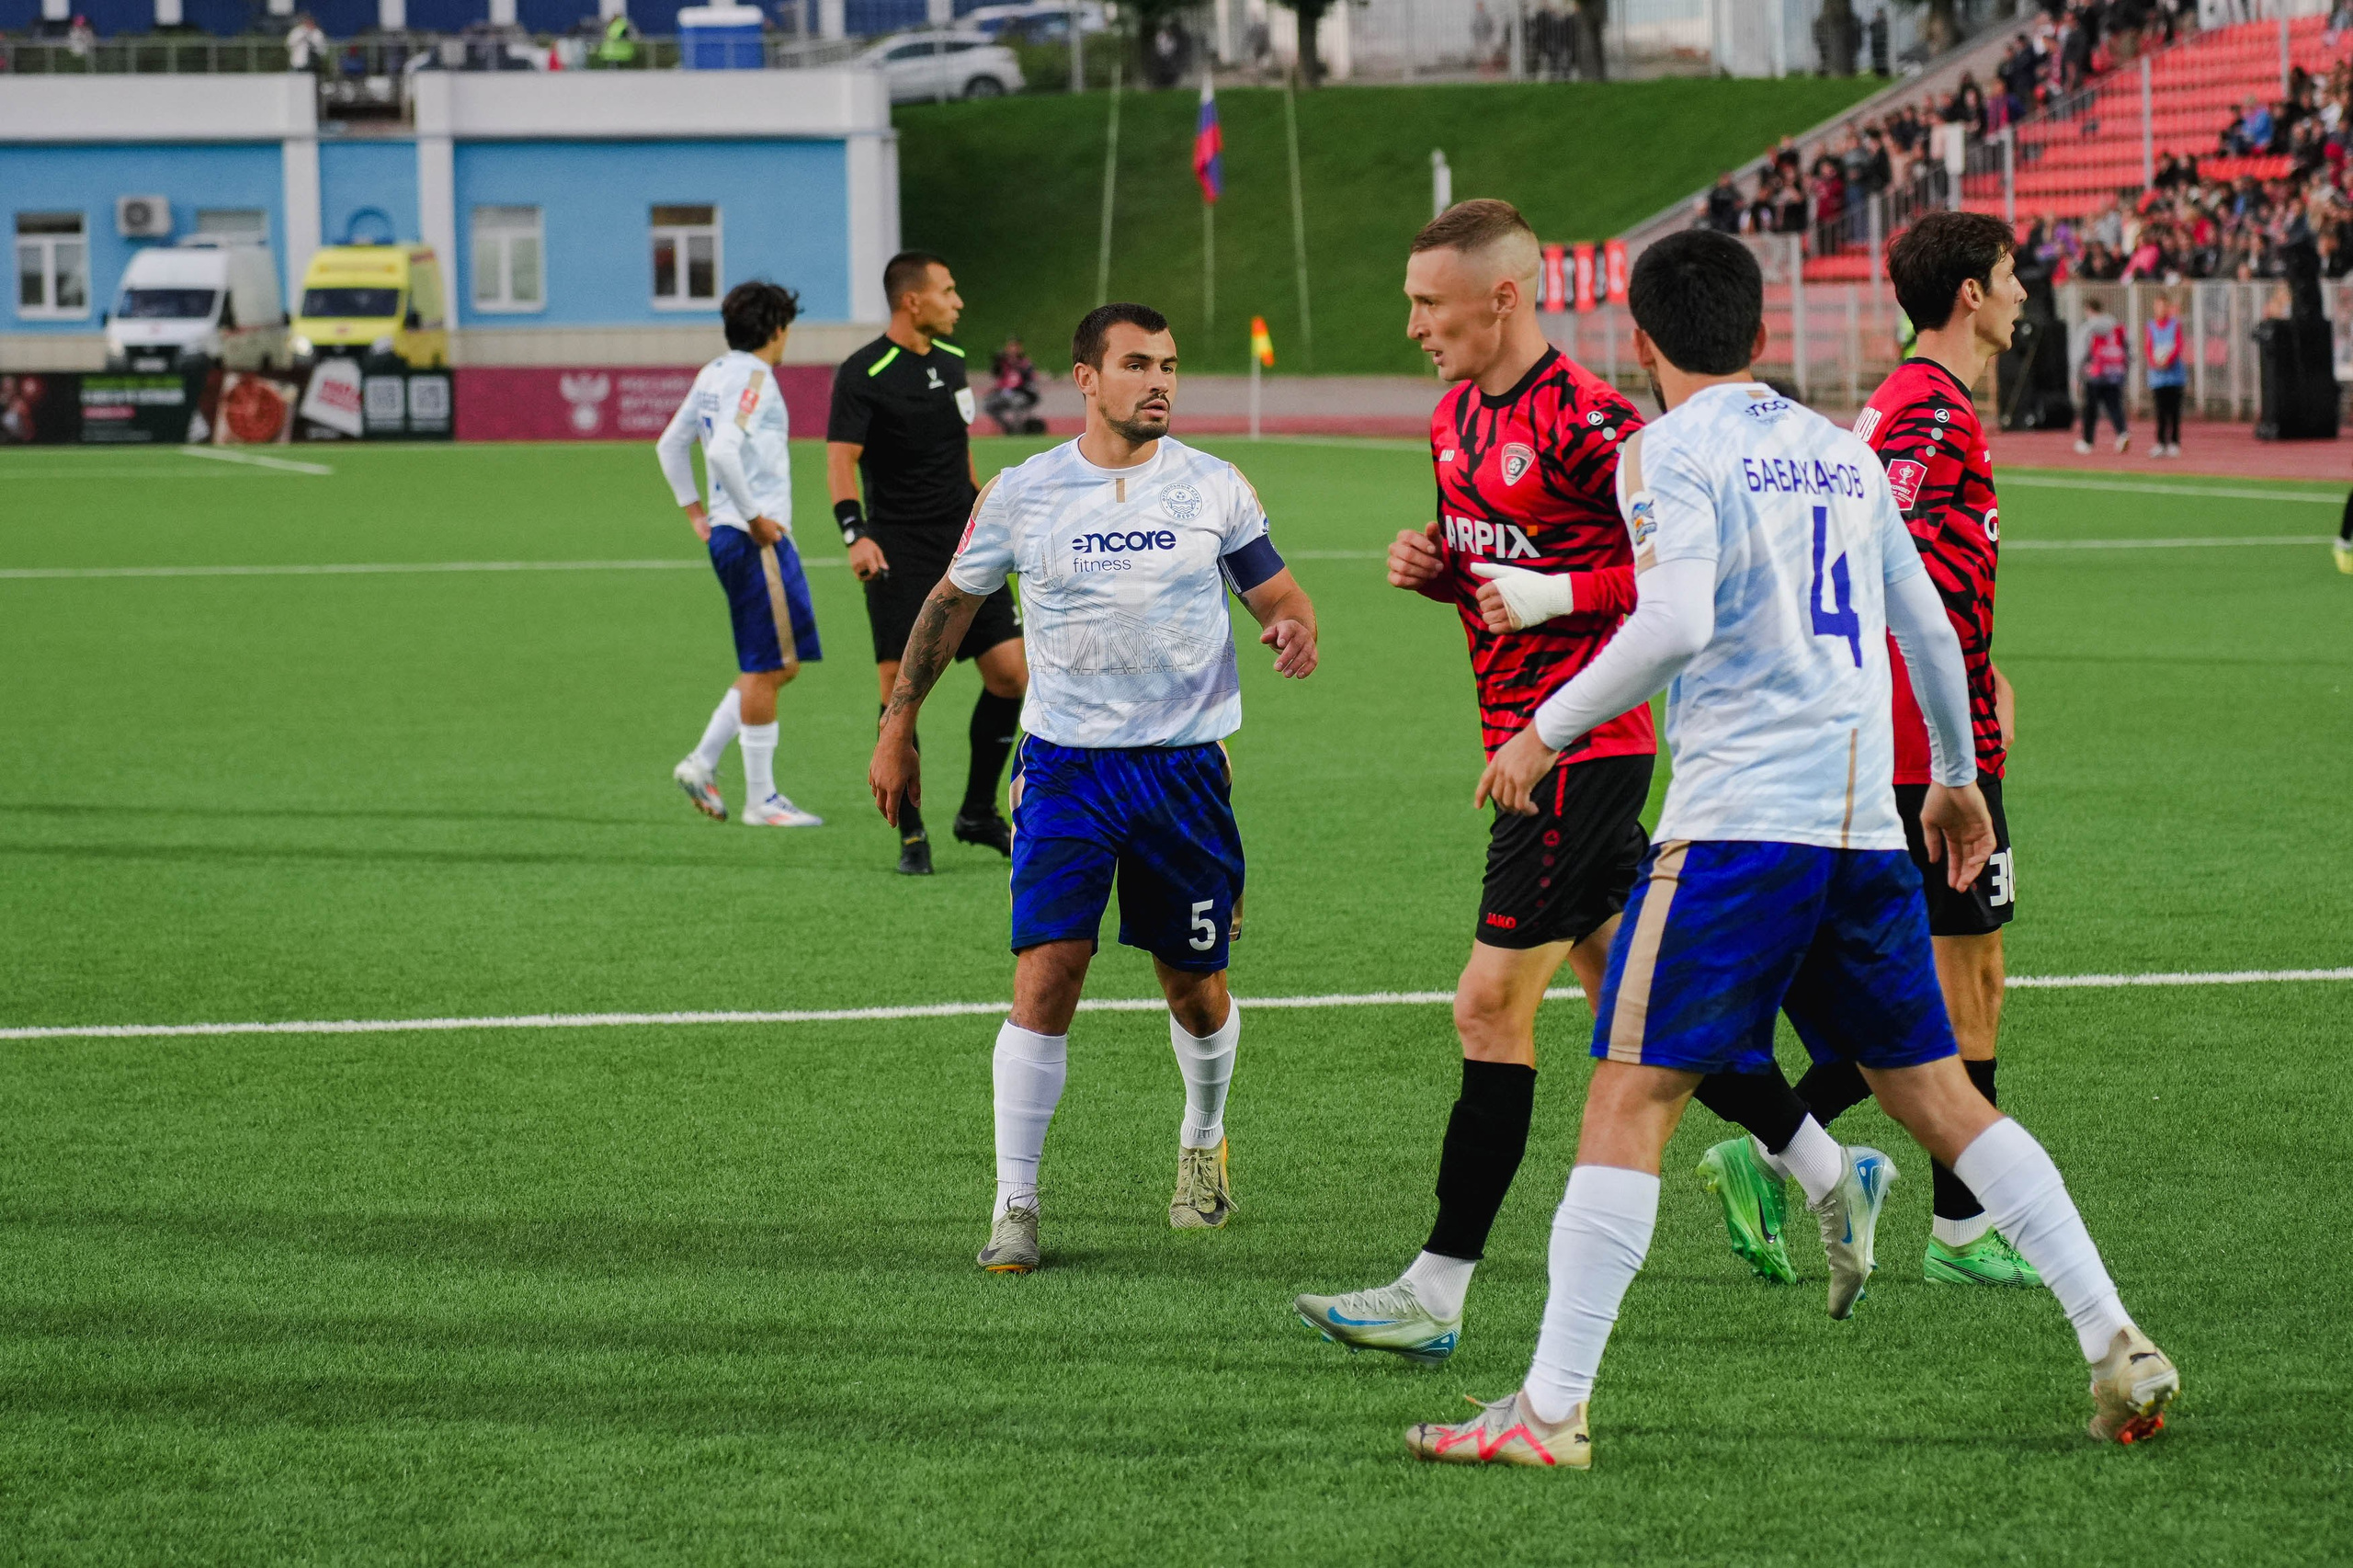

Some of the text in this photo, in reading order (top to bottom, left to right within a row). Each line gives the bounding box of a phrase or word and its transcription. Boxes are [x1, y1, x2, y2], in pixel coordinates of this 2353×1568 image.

[1743, 458, 1865, 499] БАБАХАНОВ
[1072, 529, 1176, 553] encore
[1445, 515, 1541, 559] ARPIX
[1073, 557, 1131, 574] fitness
[1810, 506, 1862, 668] 4
[1188, 899, 1216, 951] 5
[1485, 912, 1518, 929] JAKO
